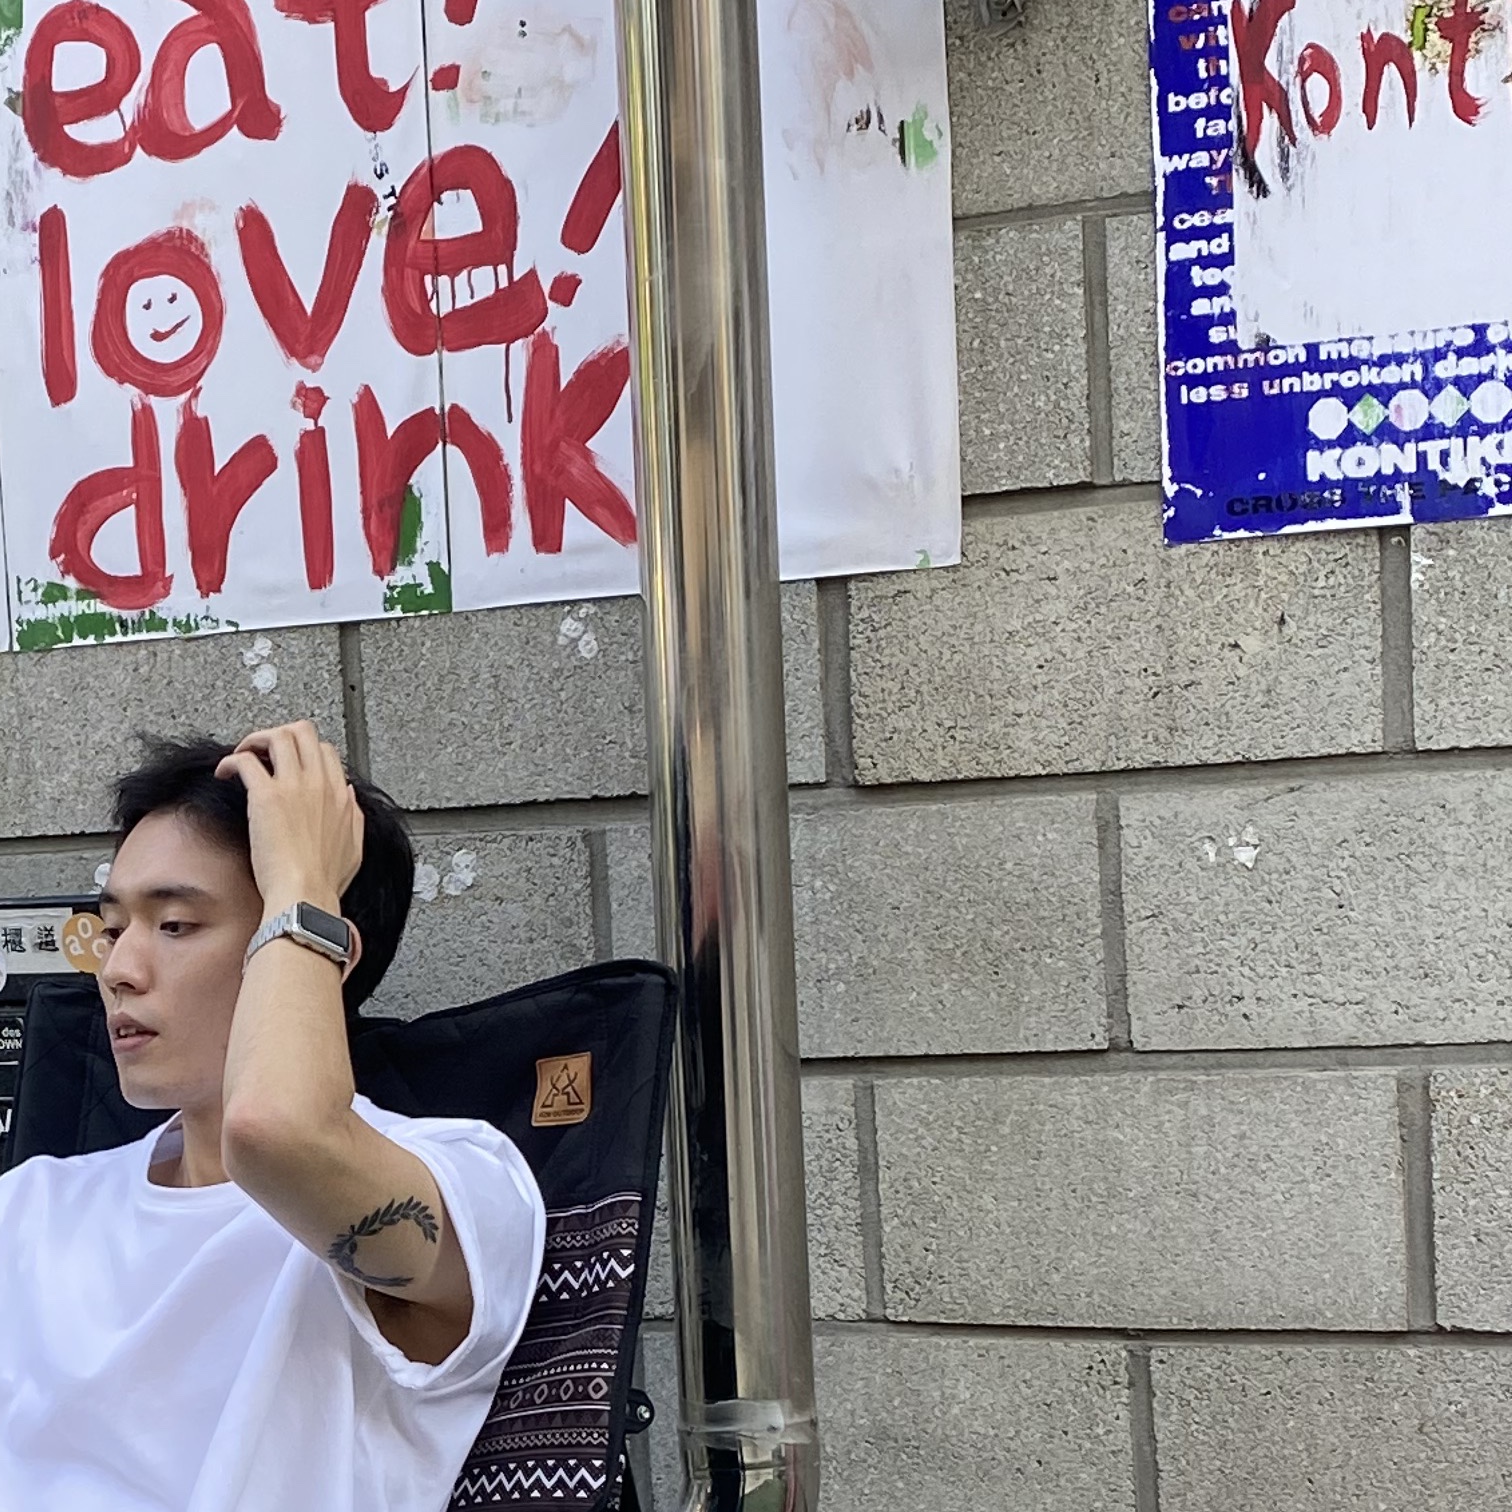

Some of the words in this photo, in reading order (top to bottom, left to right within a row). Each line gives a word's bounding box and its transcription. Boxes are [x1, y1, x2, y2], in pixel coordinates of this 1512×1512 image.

[1166, 346, 1307, 377] common
[1180, 382, 1249, 404] less
[1263, 361, 1424, 397] unbroken
[48, 325, 640, 612] drink
